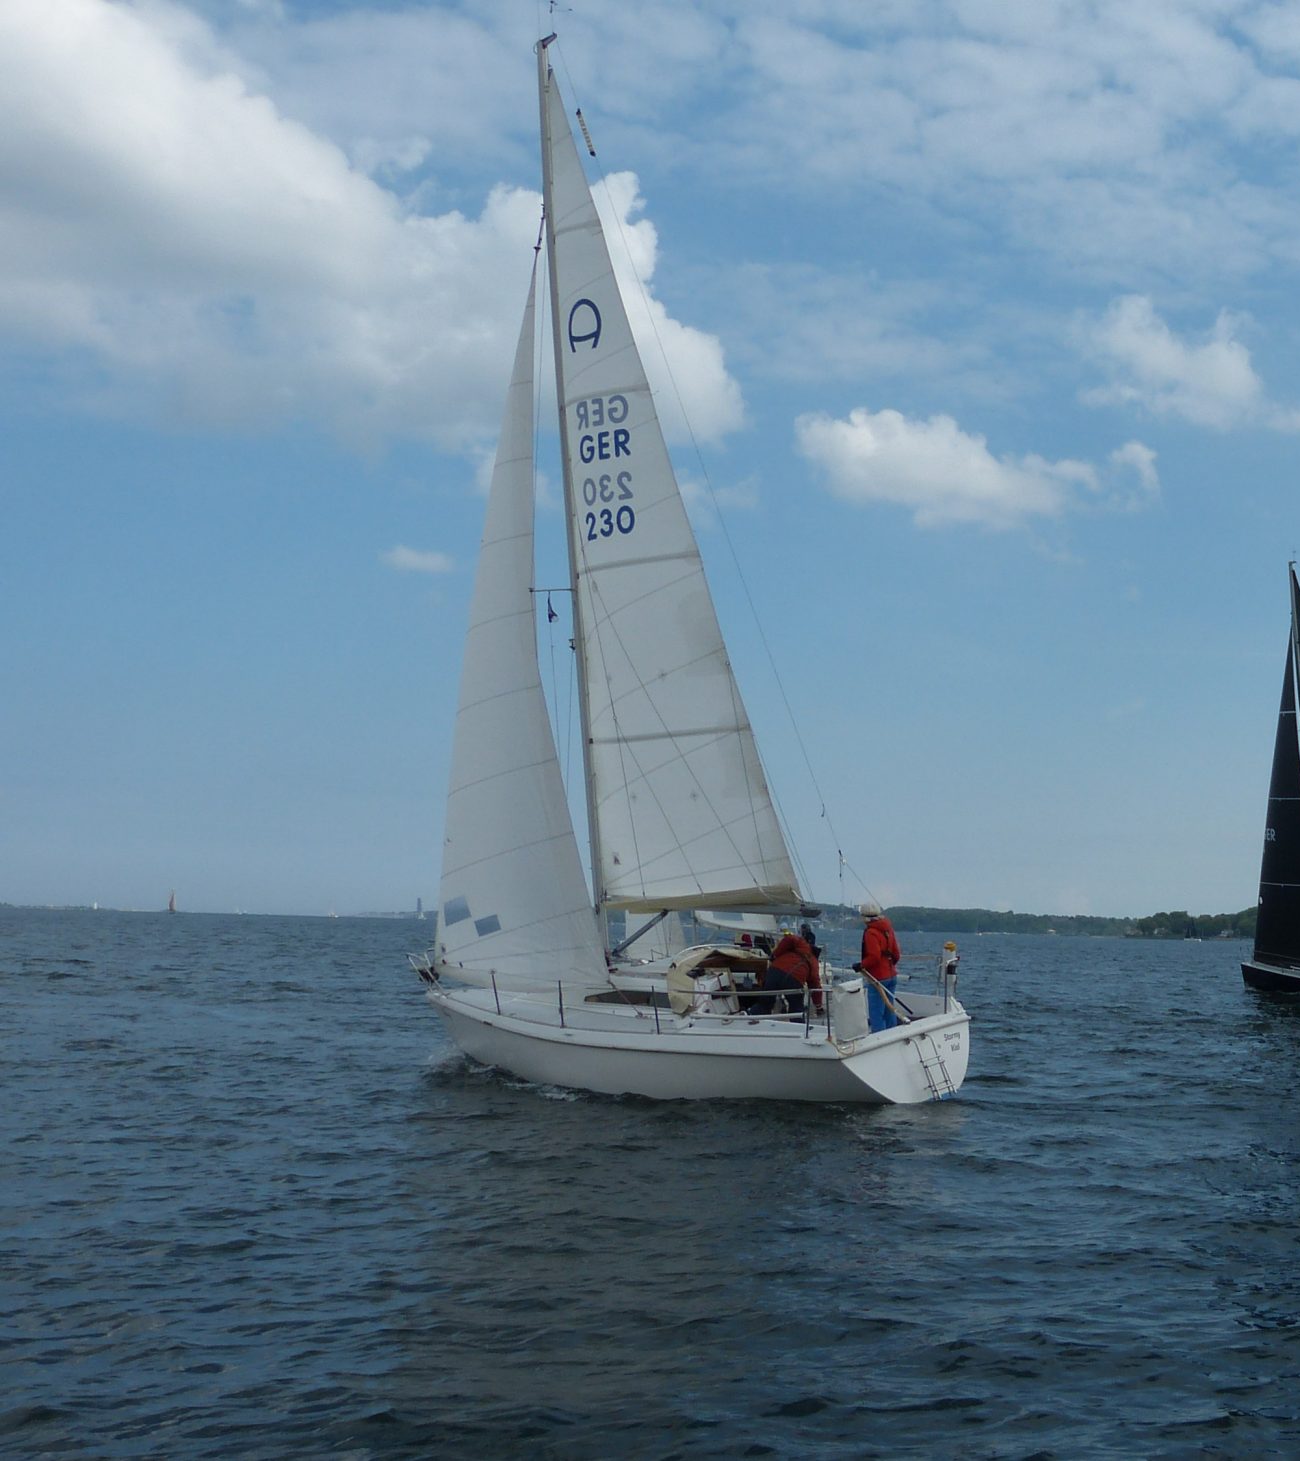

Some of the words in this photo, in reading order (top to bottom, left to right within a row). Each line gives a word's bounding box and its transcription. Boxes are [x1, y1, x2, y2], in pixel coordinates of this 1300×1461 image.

[568, 299, 602, 353] A
[579, 428, 632, 464] GER
[586, 505, 635, 541] 230
